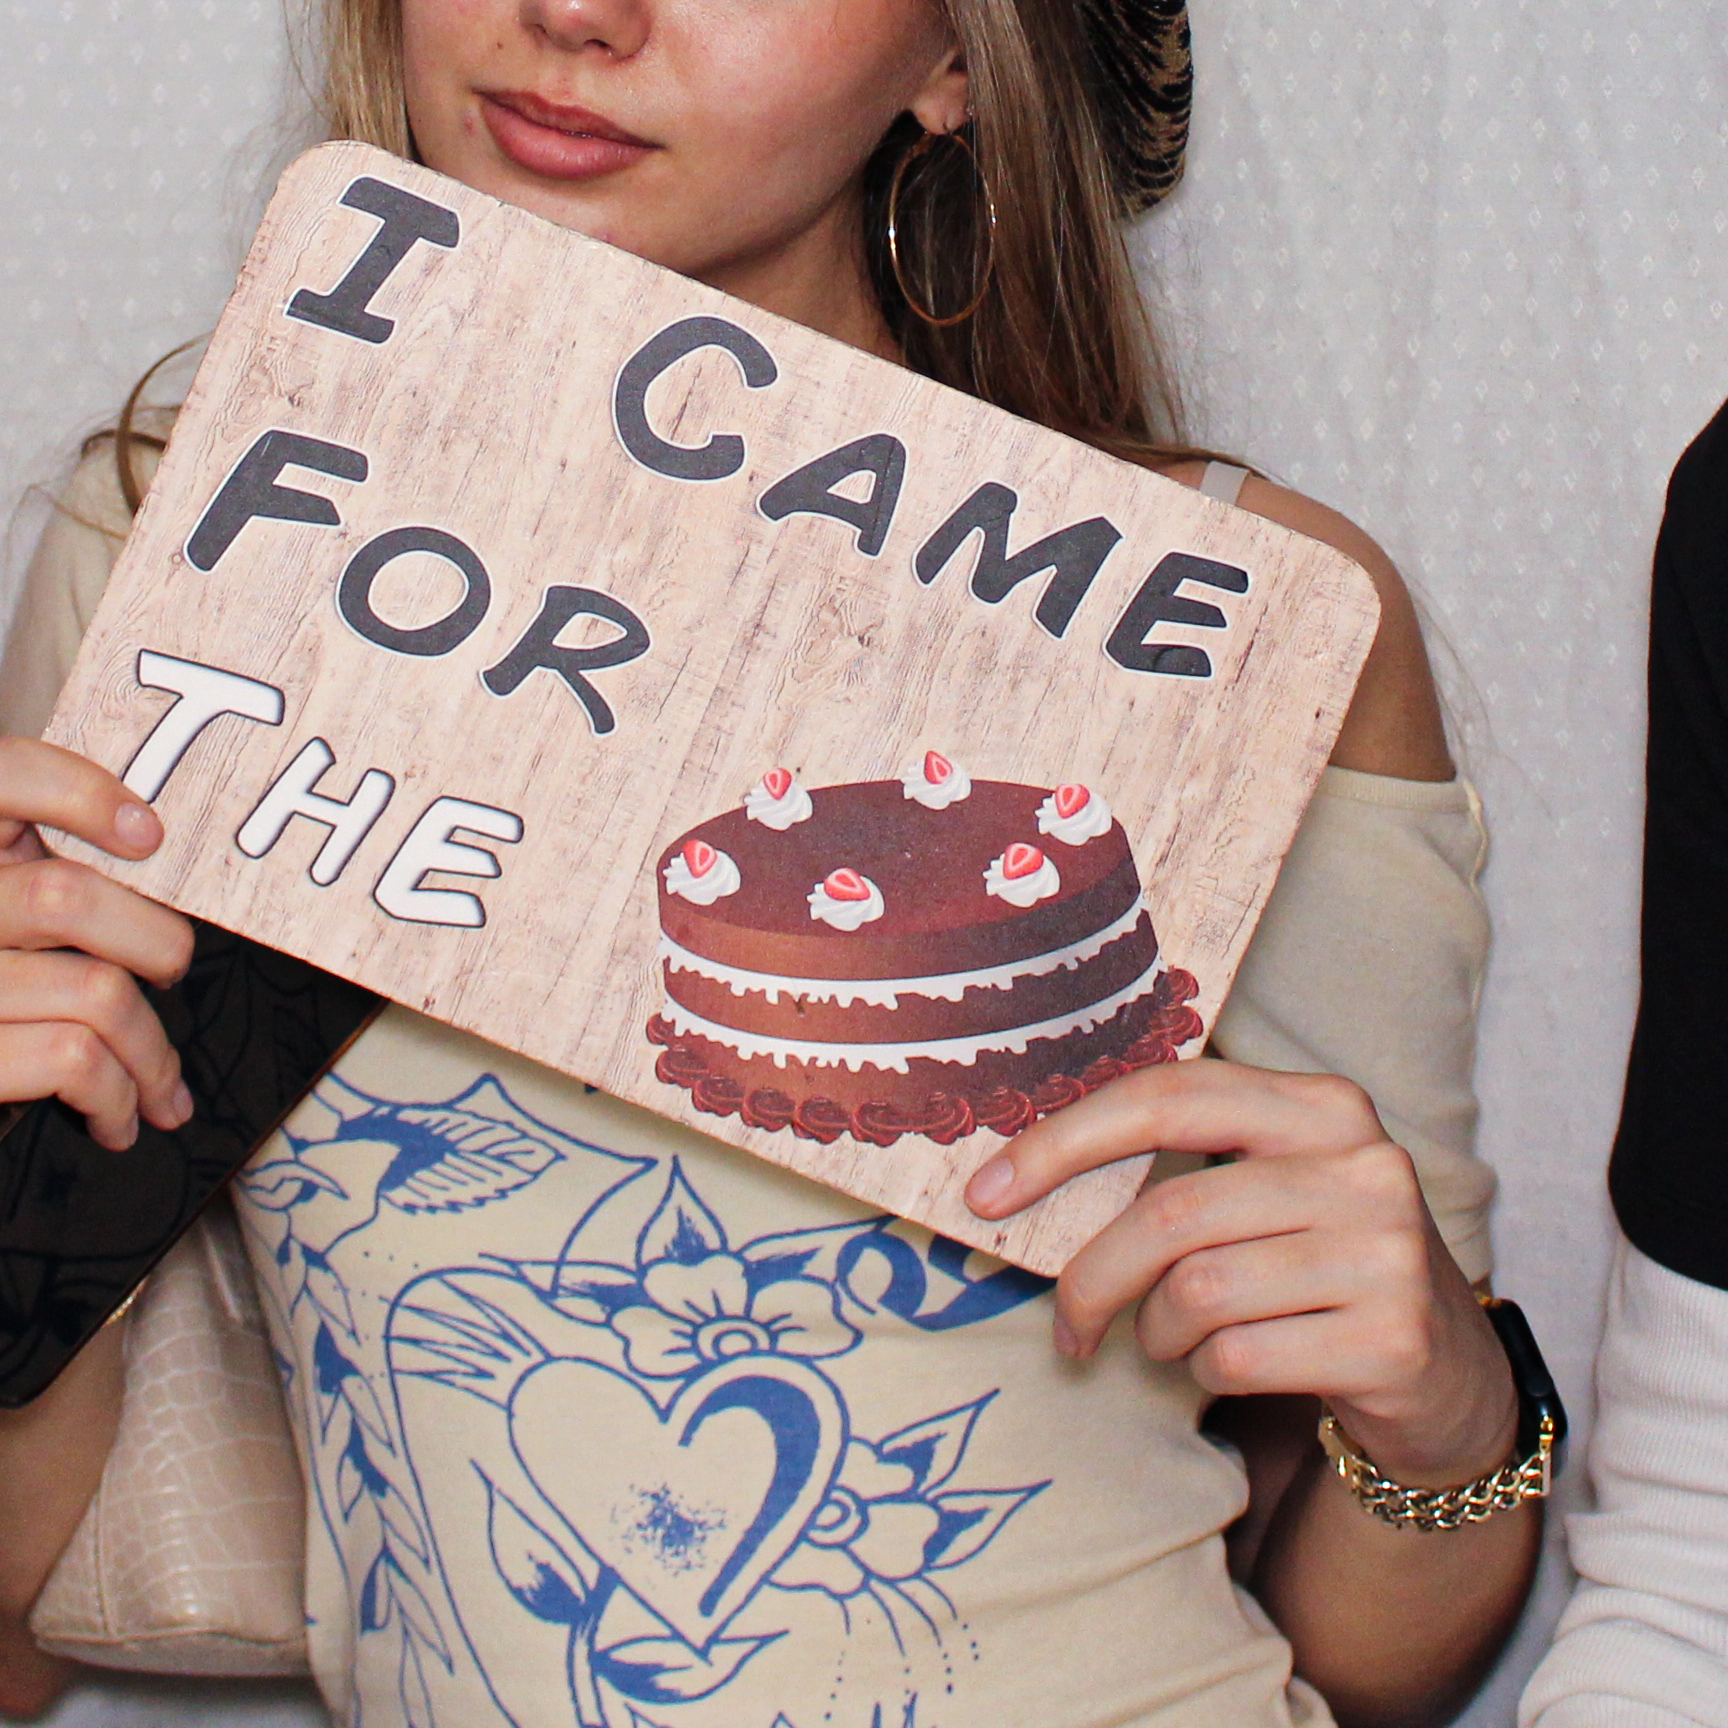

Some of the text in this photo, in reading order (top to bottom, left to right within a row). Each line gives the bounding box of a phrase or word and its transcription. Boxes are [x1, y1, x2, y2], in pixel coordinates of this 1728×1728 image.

[284, 175, 1250, 678] I CAME
[185, 428, 651, 736] FOR
[122, 649, 524, 928] THE
